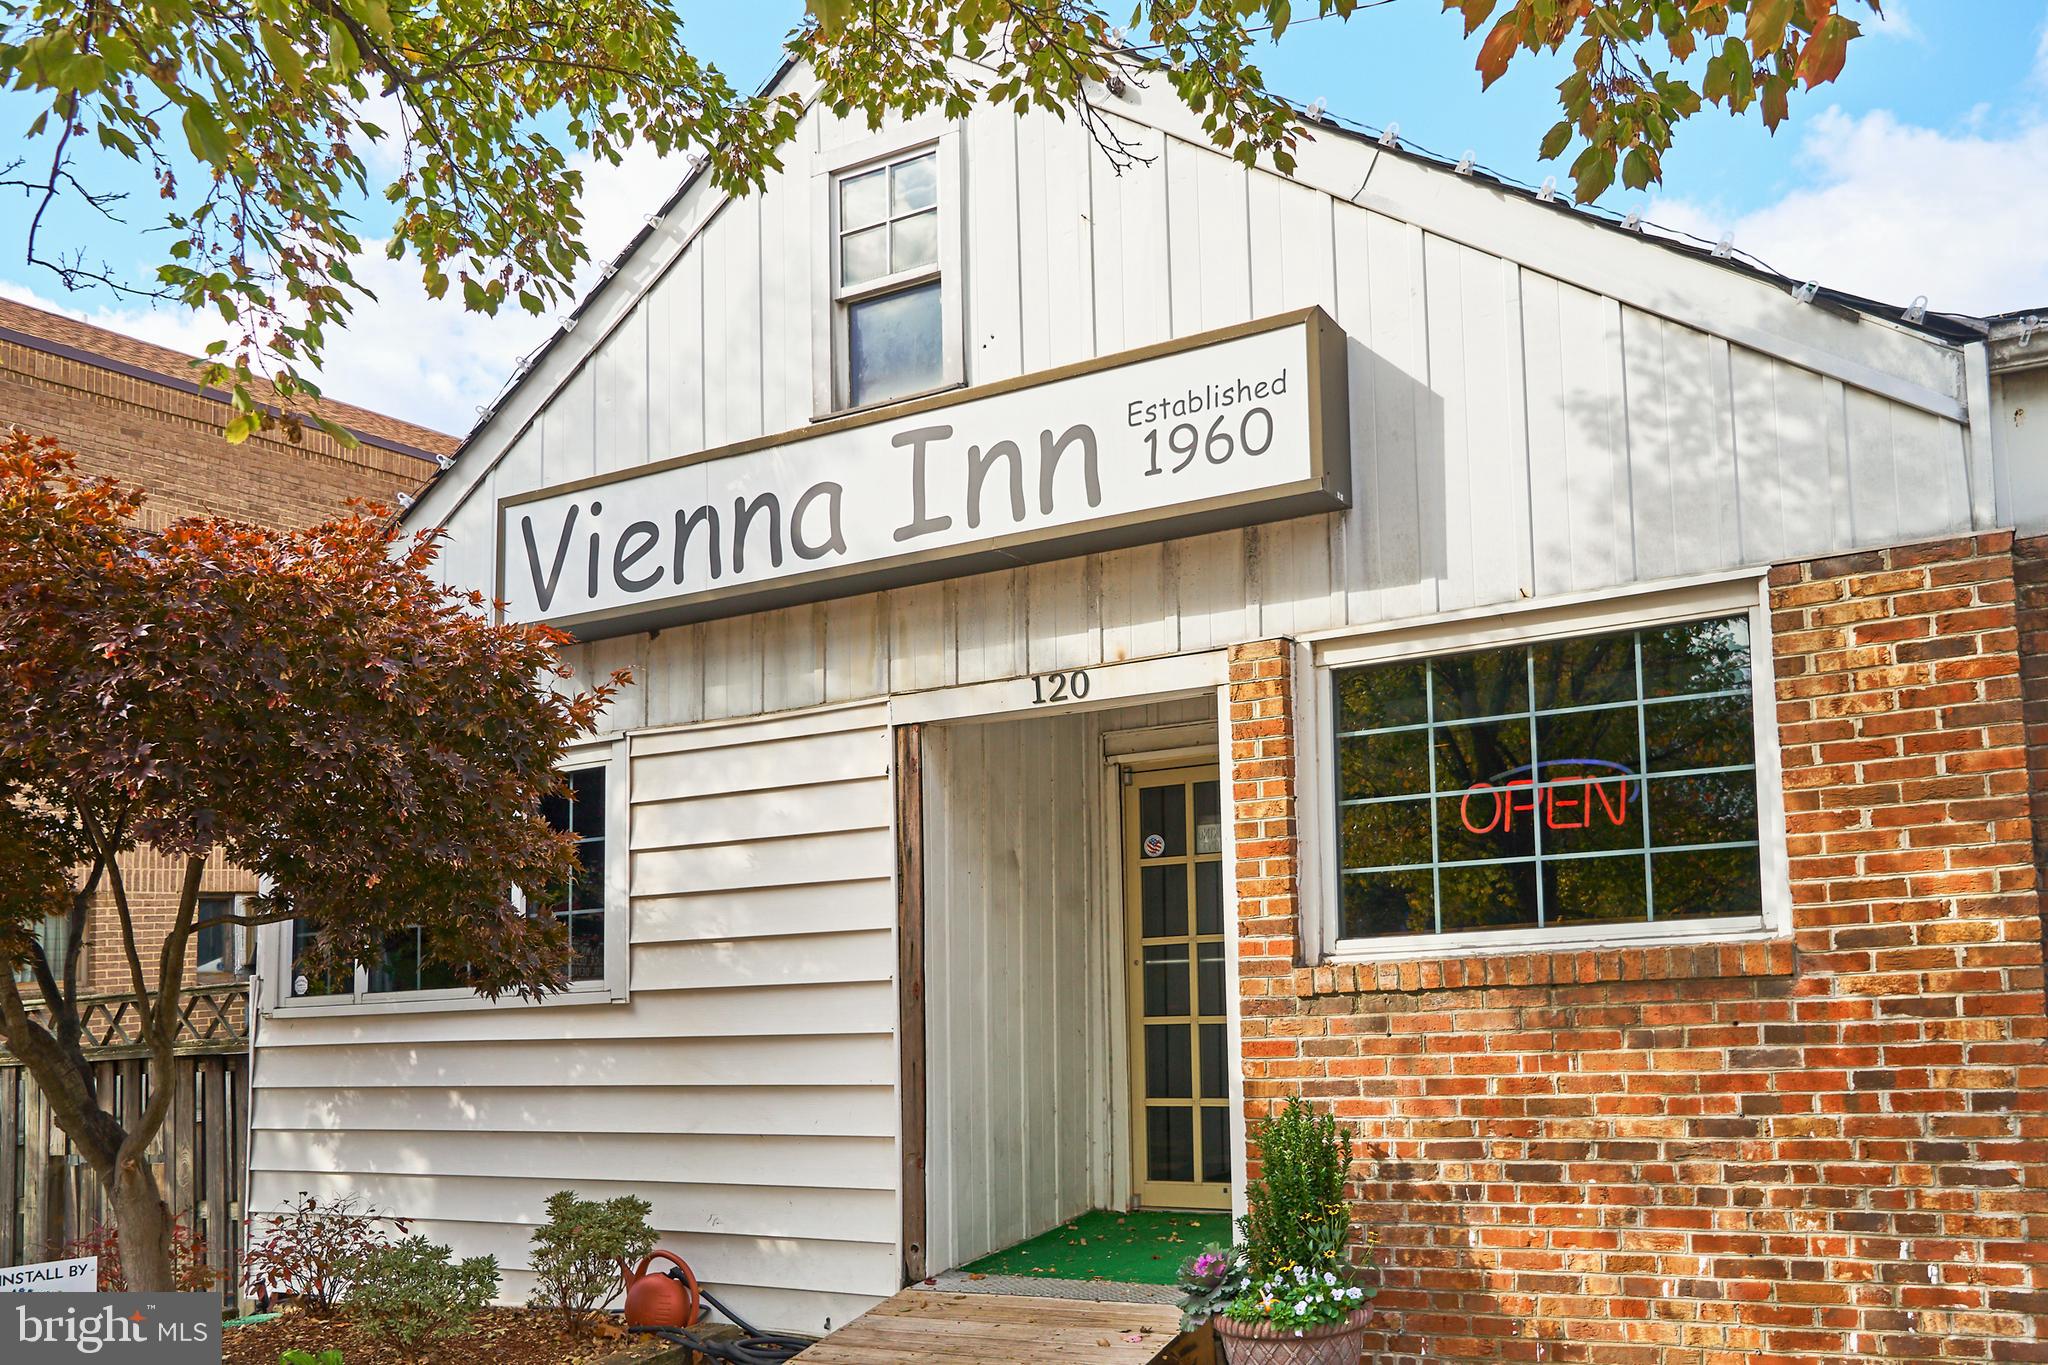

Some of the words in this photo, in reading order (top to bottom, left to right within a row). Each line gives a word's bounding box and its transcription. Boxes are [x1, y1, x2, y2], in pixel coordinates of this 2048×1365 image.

[1128, 368, 1287, 427] Established
[1144, 407, 1274, 477] 1960
[521, 481, 847, 613] Vienna
[891, 423, 1102, 543] Inn
[1031, 670, 1090, 704] 120
[1460, 774, 1627, 834] OPEN
[69, 1263, 88, 1277] BY
